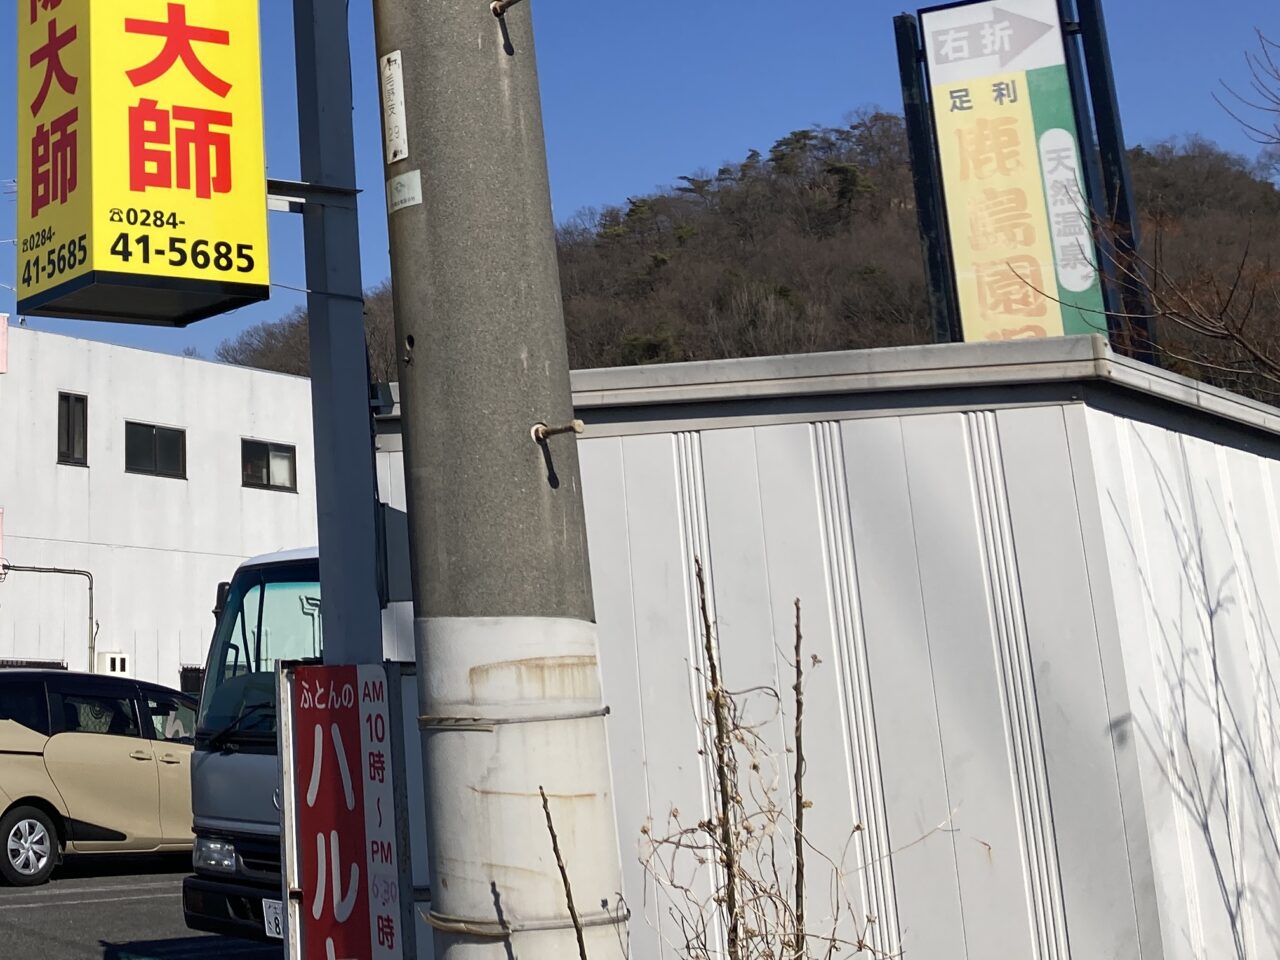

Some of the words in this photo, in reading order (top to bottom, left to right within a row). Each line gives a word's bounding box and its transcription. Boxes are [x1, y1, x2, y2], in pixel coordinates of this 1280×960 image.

[938, 21, 1014, 61] 右折
[949, 80, 1018, 112] 足利
[954, 116, 1048, 342] 鹿島園
[1046, 147, 1088, 270] 天然温泉
[22, 234, 88, 288] 41-5685
[110, 233, 255, 274] 41-5685
[300, 680, 355, 710] ふとんの
[306, 723, 359, 960] ハル
